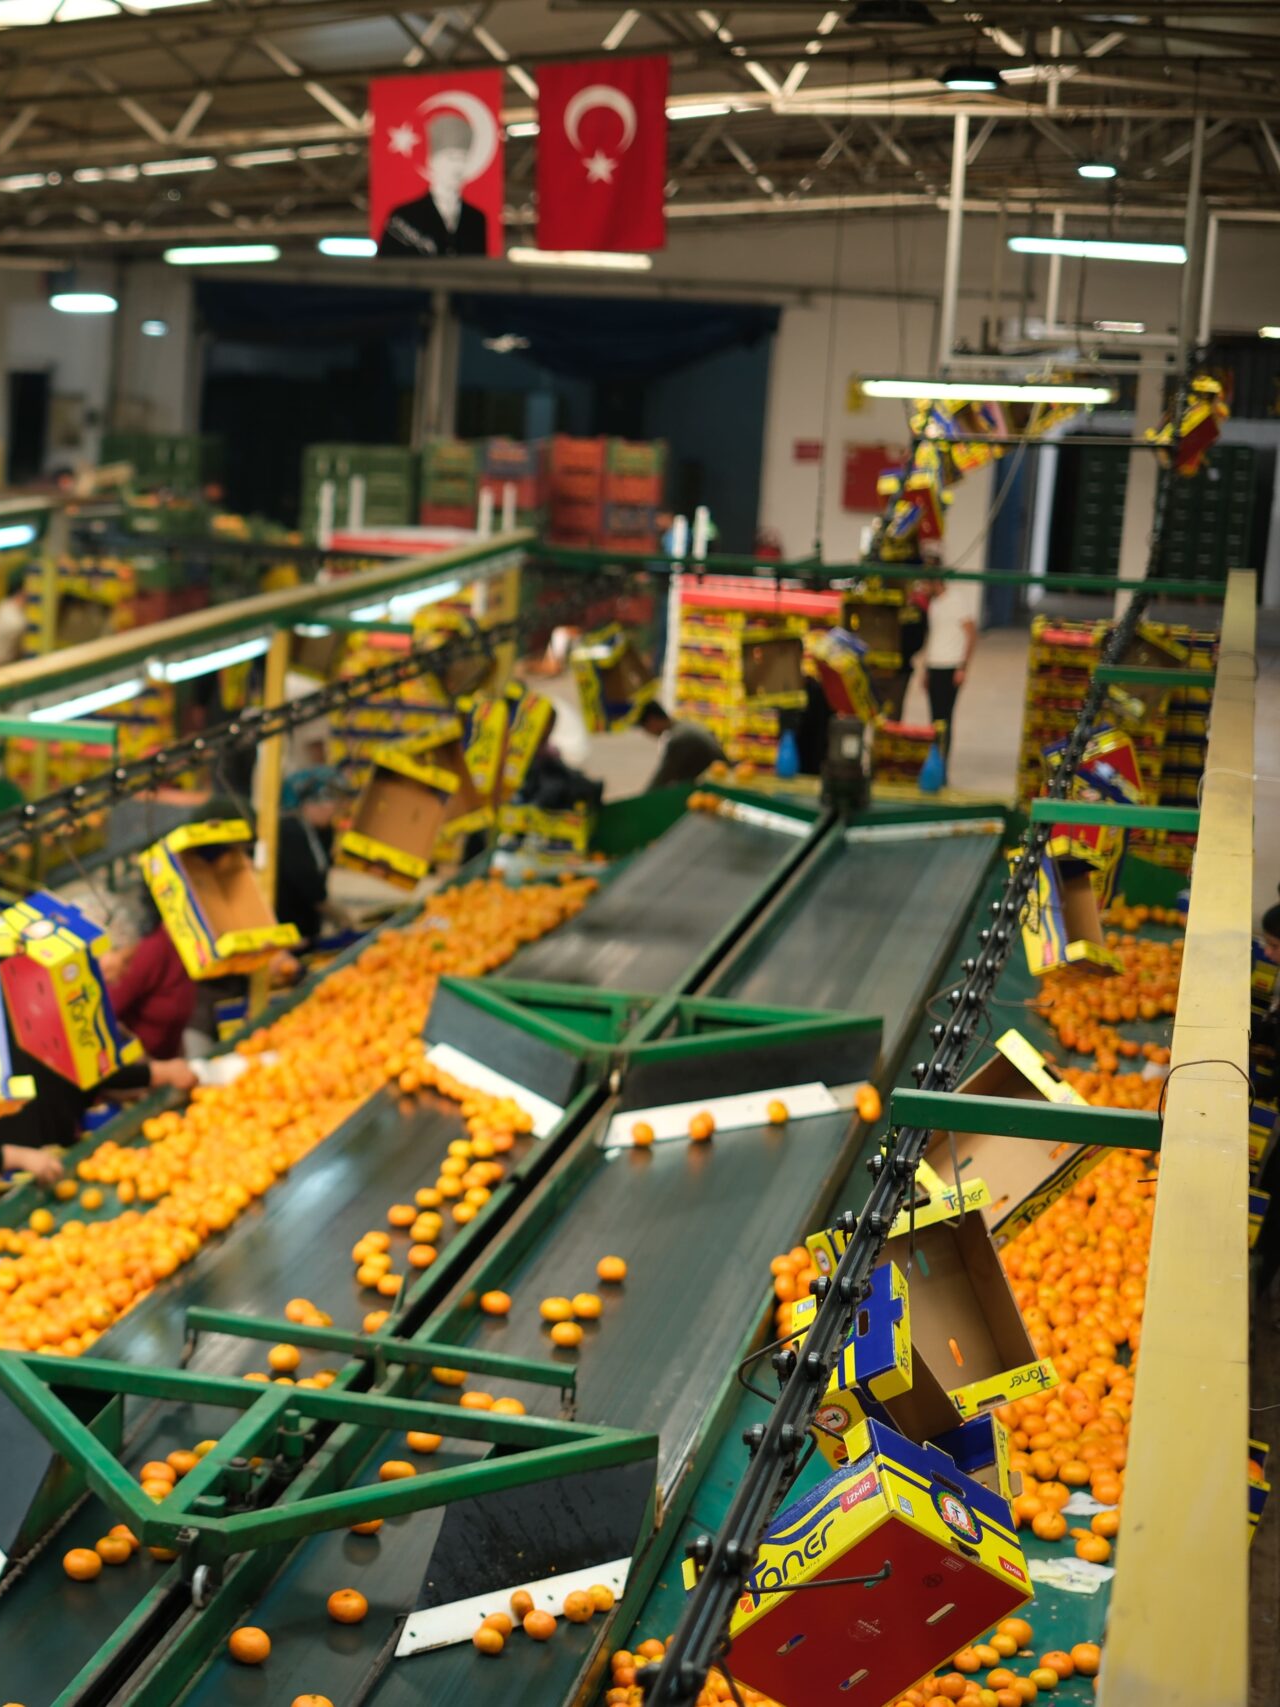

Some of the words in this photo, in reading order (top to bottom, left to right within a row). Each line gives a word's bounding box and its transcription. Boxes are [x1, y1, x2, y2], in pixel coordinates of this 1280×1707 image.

[66, 984, 96, 1048] Taner
[1013, 1166, 1082, 1224] Taner
[1009, 1365, 1051, 1389] Taner
[744, 1518, 835, 1609] Taner
